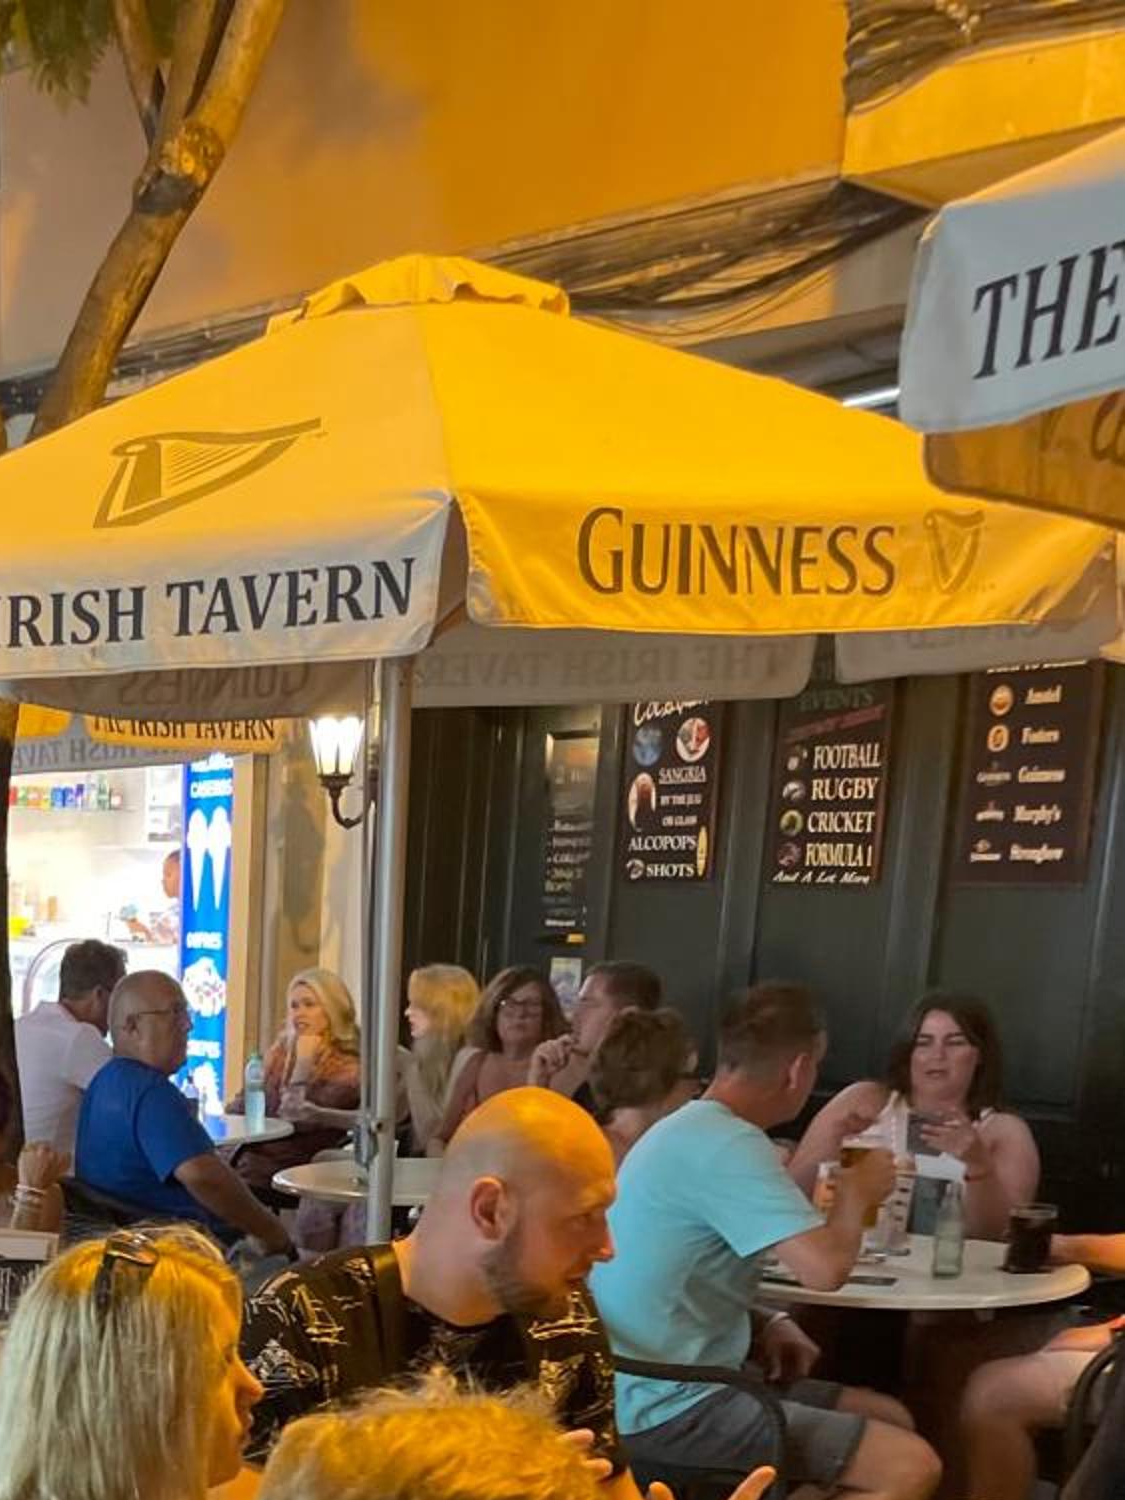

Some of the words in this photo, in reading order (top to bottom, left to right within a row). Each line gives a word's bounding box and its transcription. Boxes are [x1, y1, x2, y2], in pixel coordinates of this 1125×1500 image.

[972, 239, 1125, 380] THE
[577, 506, 896, 596] GUINNESS
[167, 557, 418, 638] TAVERN
[813, 743, 881, 769] FOOTBALL
[811, 777, 879, 801] RUGBY
[807, 811, 875, 833] CRICKET
[628, 835, 697, 851] ALCOPOPS
[804, 843, 863, 867] FORMULA
[866, 845, 873, 867] 1
[646, 863, 695, 878] SHOTS
